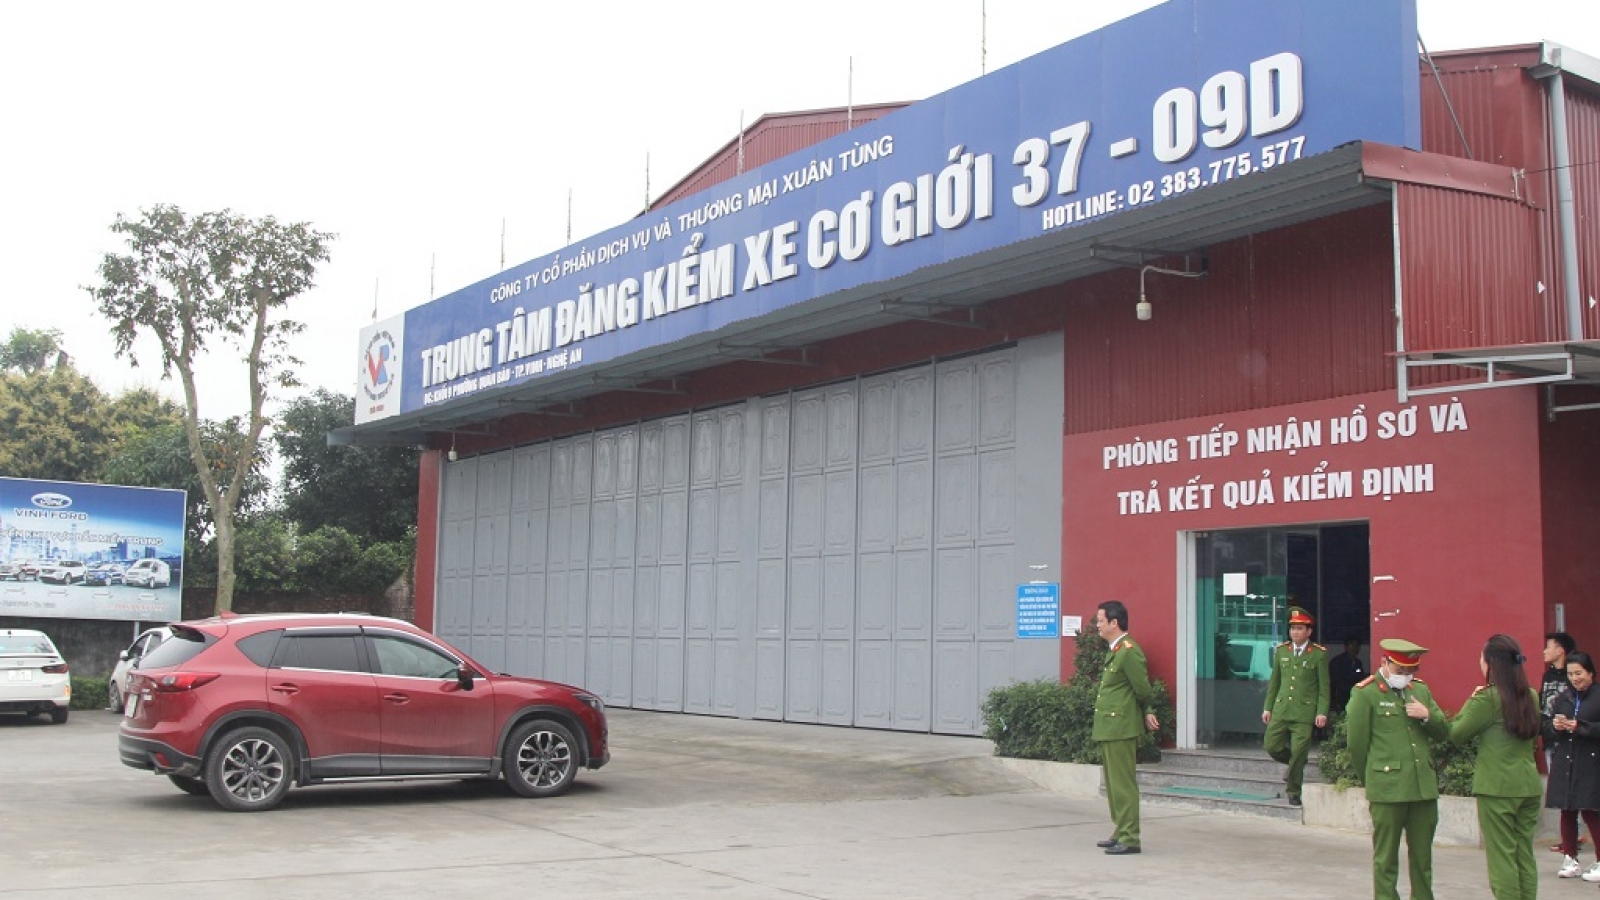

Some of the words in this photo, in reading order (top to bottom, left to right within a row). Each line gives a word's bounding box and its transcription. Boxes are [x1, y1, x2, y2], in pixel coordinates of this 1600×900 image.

[421, 327, 494, 388] TRUNG
[496, 306, 552, 365] TÂM
[556, 276, 641, 348] ĐĂNG
[643, 232, 736, 321] KIỂM
[742, 219, 799, 292] XE
[807, 190, 875, 270] CƠ
[880, 143, 994, 248] GIỚI
[1012, 120, 1092, 208] 37
[1111, 137, 1138, 159] -
[1152, 51, 1304, 163] 09D
[490, 278, 522, 304] CÔNG
[525, 270, 540, 291] TY
[541, 254, 561, 285] CỔ
[562, 246, 596, 277] PHẦN
[598, 235, 630, 264] DỊCH
[632, 227, 651, 251] VỤ
[654, 217, 673, 242] VÀ
[678, 192, 743, 233] THƯƠNG
[748, 180, 778, 207] MẠI
[782, 159, 834, 194] XUÂN
[838, 134, 894, 171] TÙNG
[1042, 189, 1124, 230] HOTLINE:
[1128, 180, 1155, 206] 02
[1160, 135, 1306, 197] 383.775.577
[1103, 437, 1178, 470] PHÒNG
[1187, 423, 1239, 460] TIẾP
[1247, 417, 1321, 455] NHẬN
[1331, 404, 1367, 444] HỒ
[1378, 405, 1417, 440] SƠ
[1430, 396, 1468, 433] VÀ
[15, 509, 48, 518] VINH
[51, 511, 87, 521] FORD
[1117, 480, 1161, 515] TRẢ
[1169, 475, 1215, 512] KẾT
[1223, 469, 1275, 509] QUẢ
[1283, 461, 1353, 503] KIỂM
[1362, 463, 1434, 501] ĐỊNH
